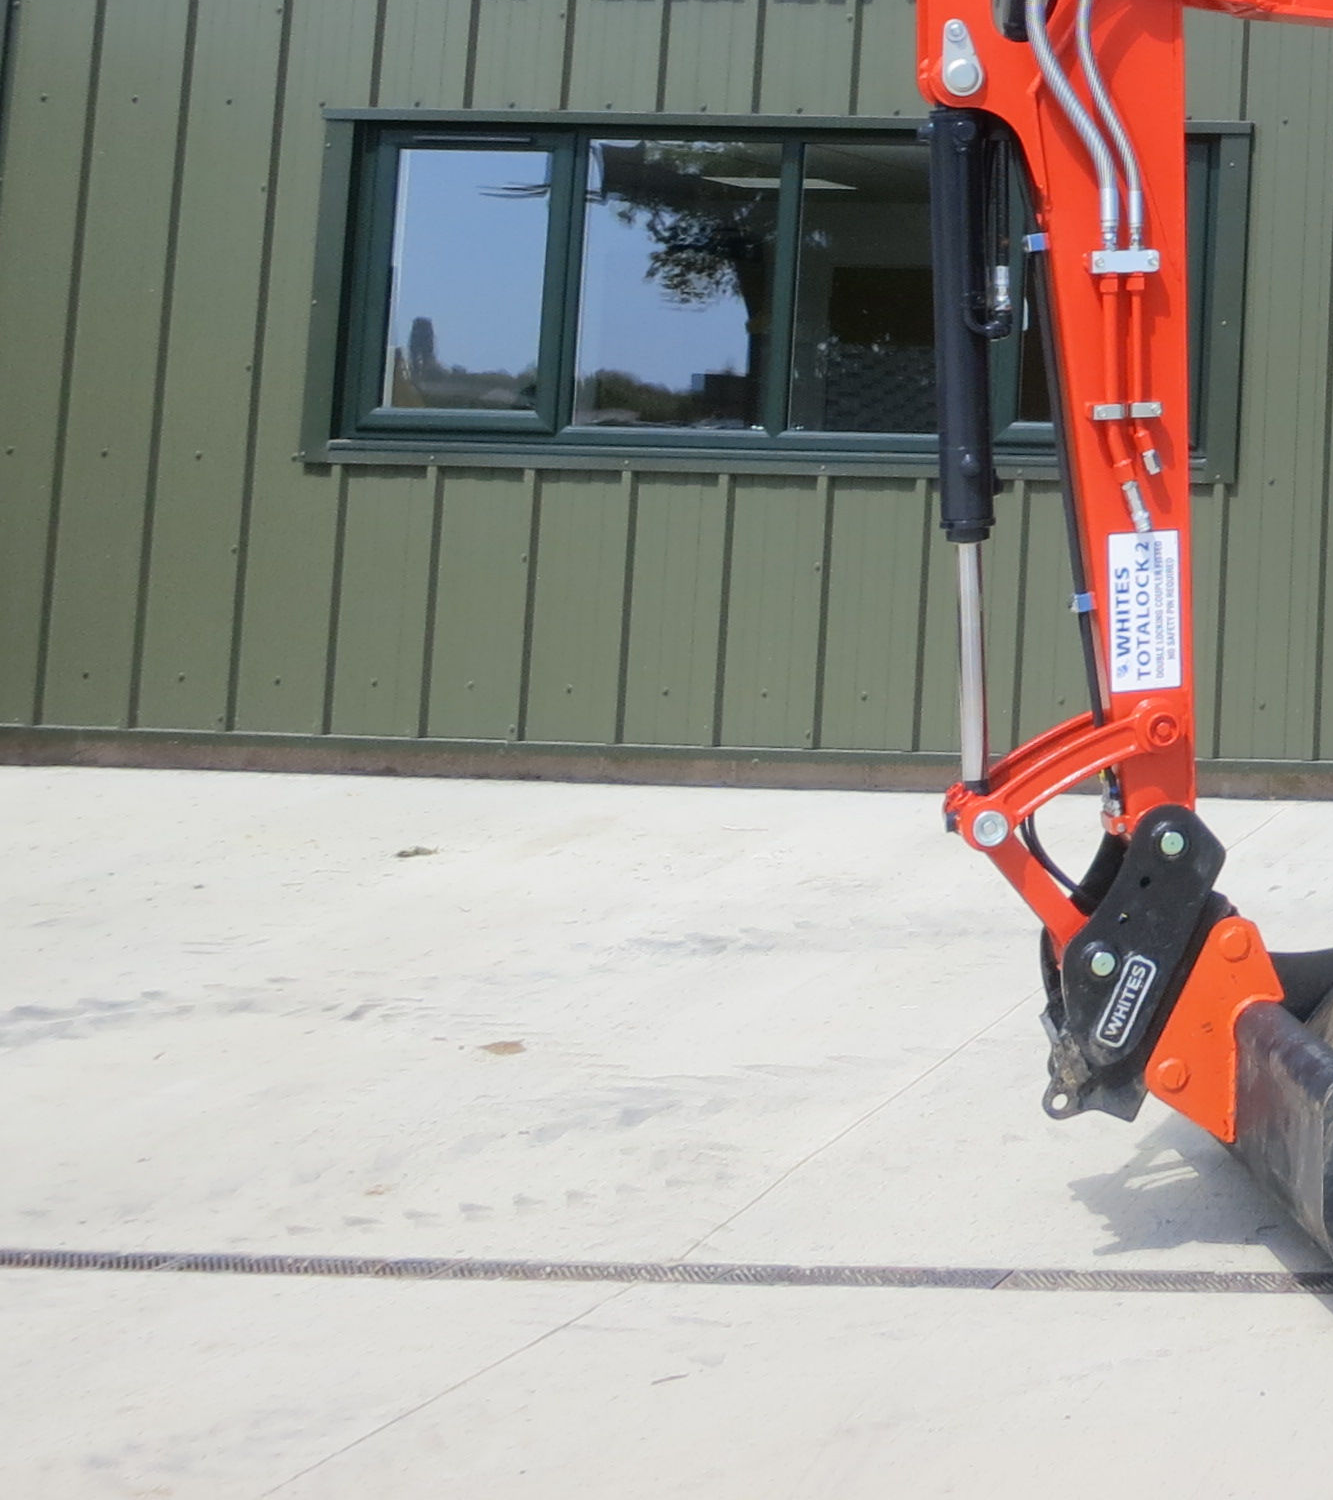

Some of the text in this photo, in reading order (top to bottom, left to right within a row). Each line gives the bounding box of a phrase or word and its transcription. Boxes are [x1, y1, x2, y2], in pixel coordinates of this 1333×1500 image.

[1114, 567, 1131, 659] WHITES
[1134, 541, 1151, 681] TOTALOCK 2
[1153, 570, 1163, 607] COUPLER
[1164, 557, 1176, 660] NO SAFETY PIN REQUIRED
[1154, 610, 1164, 644] LOCKING
[1154, 647, 1165, 679] DOUBLE
[1103, 964, 1147, 1036] WHITES
